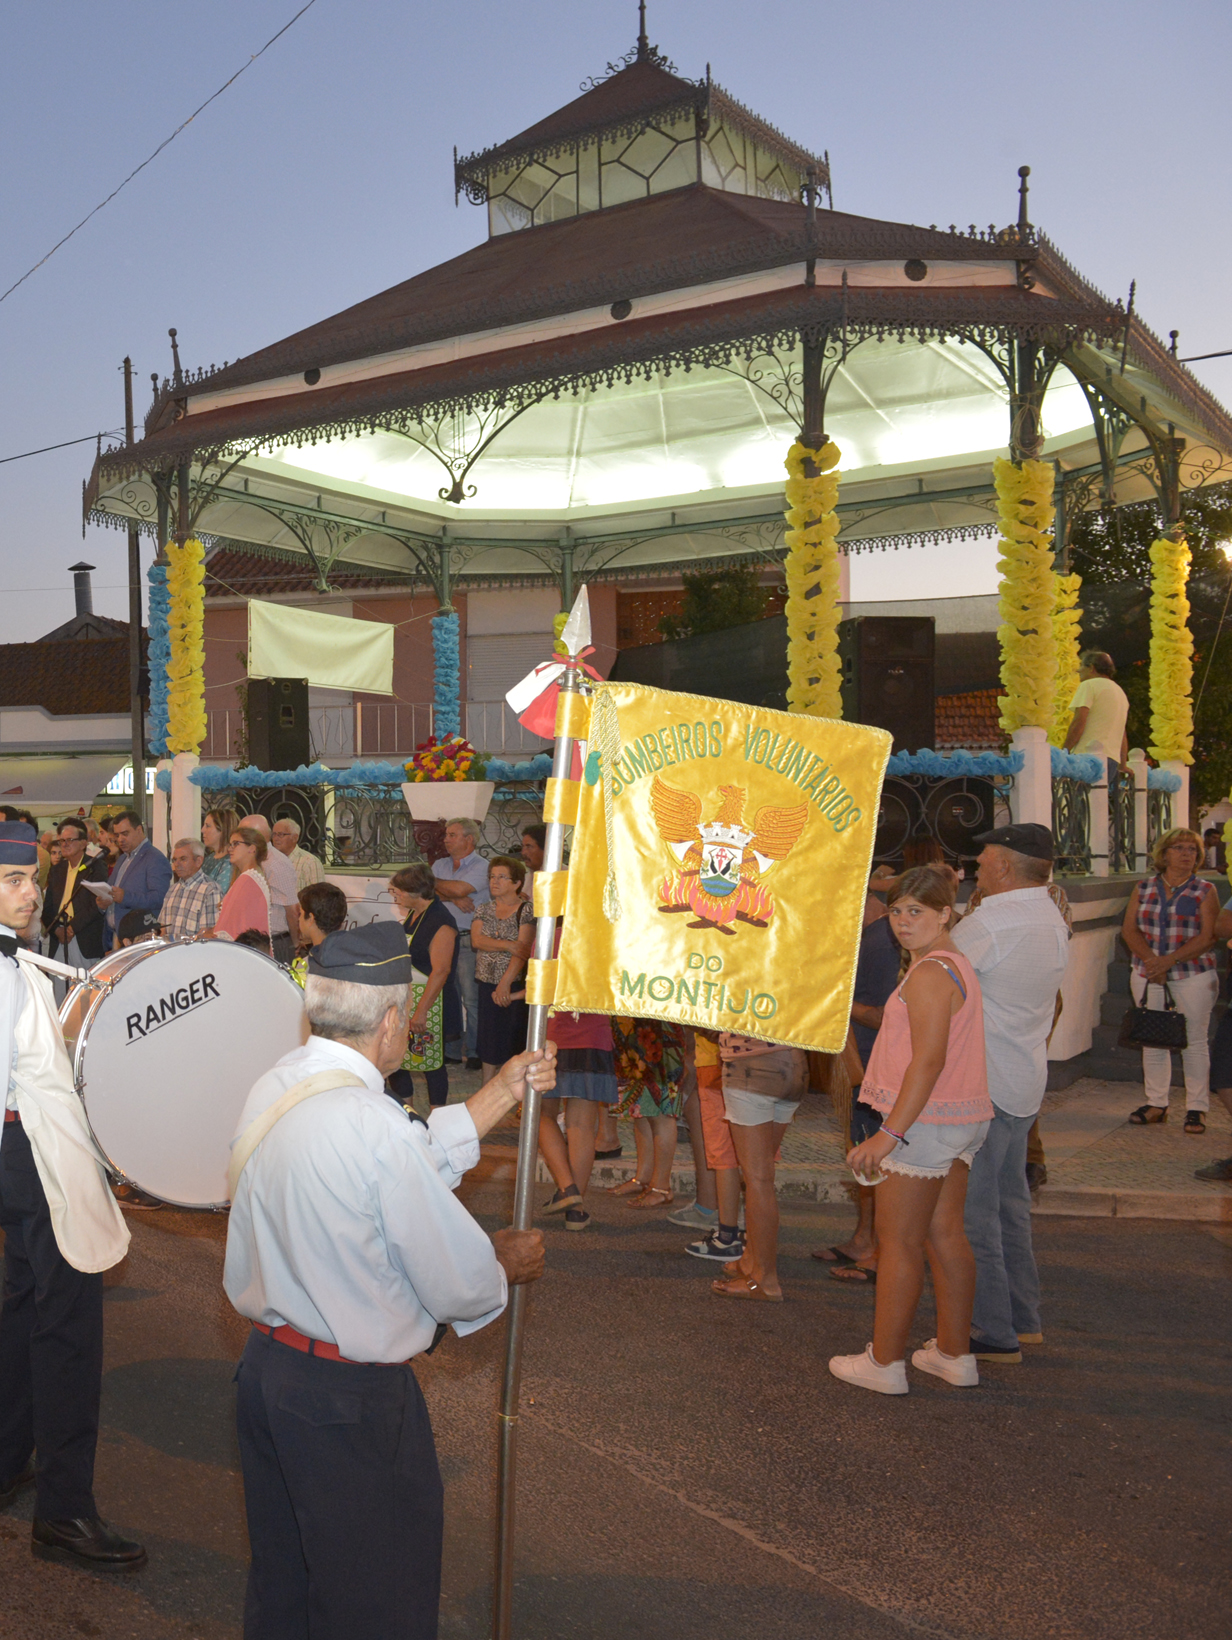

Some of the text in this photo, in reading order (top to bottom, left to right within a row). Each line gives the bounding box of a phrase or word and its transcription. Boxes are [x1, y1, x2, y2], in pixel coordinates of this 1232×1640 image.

[745, 724, 862, 833] VOLUNTÁRIOS
[688, 952, 722, 972] DO
[126, 973, 221, 1040] RANGER
[620, 969, 777, 1020] MONTIJO
